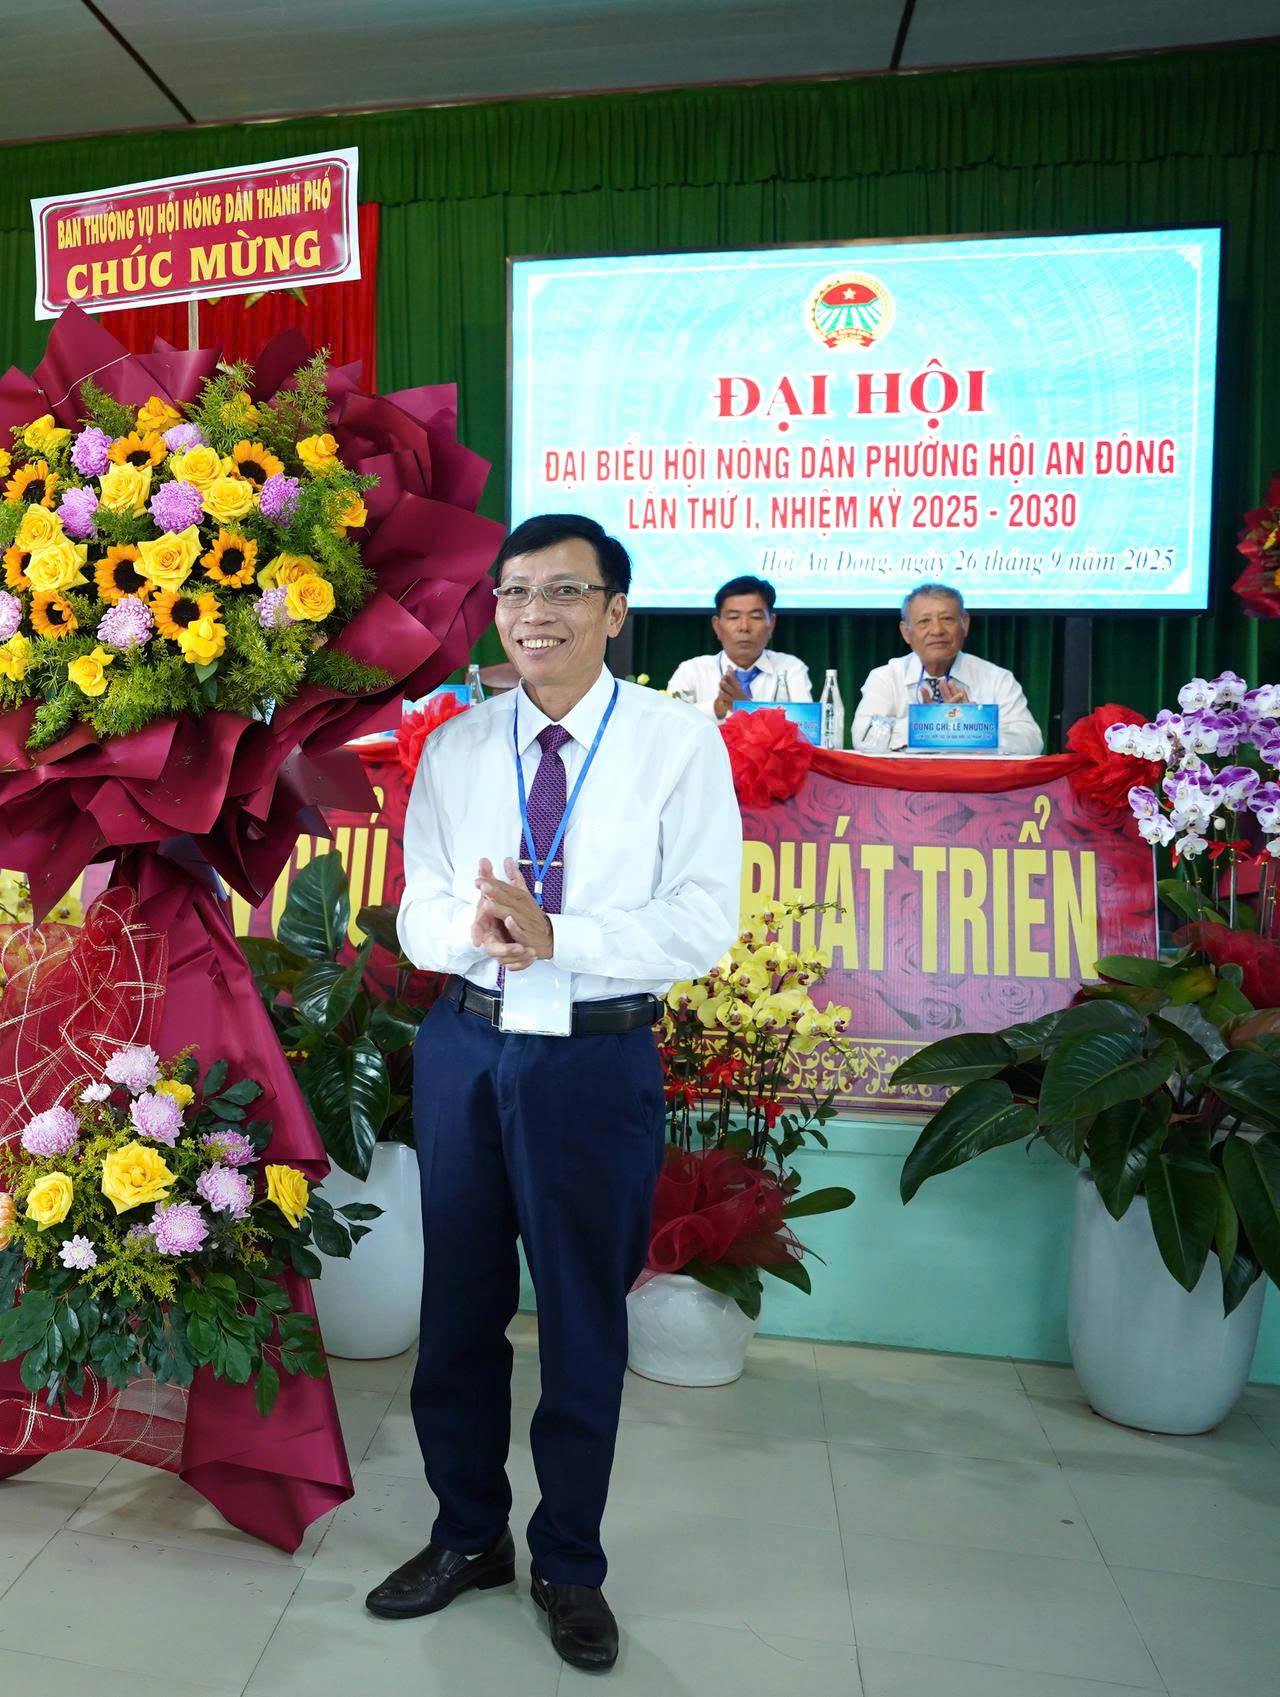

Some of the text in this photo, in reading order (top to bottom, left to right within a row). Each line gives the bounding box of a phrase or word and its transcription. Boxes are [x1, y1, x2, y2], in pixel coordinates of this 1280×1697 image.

[57, 166, 332, 250] BAN THƯỜNG VỤ HỘI NÔNG DÂN THÀNH PHỐ
[66, 229, 322, 300] CHÚC MỪNG
[713, 358, 987, 432] ĐẠI HỘI
[545, 432, 1175, 489] ĐẠI BIỂU HỘI NÔNG DÂN PHƯỜNG HỘI AN ĐÔNG
[629, 486, 677, 529] LẦN
[687, 488, 738, 529] THỨ
[771, 488, 857, 537] NHIỆM
[869, 487, 902, 528] KỲ
[912, 495, 978, 528] 2025
[1008, 493, 1077, 528] 2030
[954, 550, 977, 571] 26
[1050, 550, 1063, 570] 9
[1124, 548, 1174, 571] 2025
[740, 815, 894, 971] PHÁT
[913, 794, 1099, 981] TRIỂN
